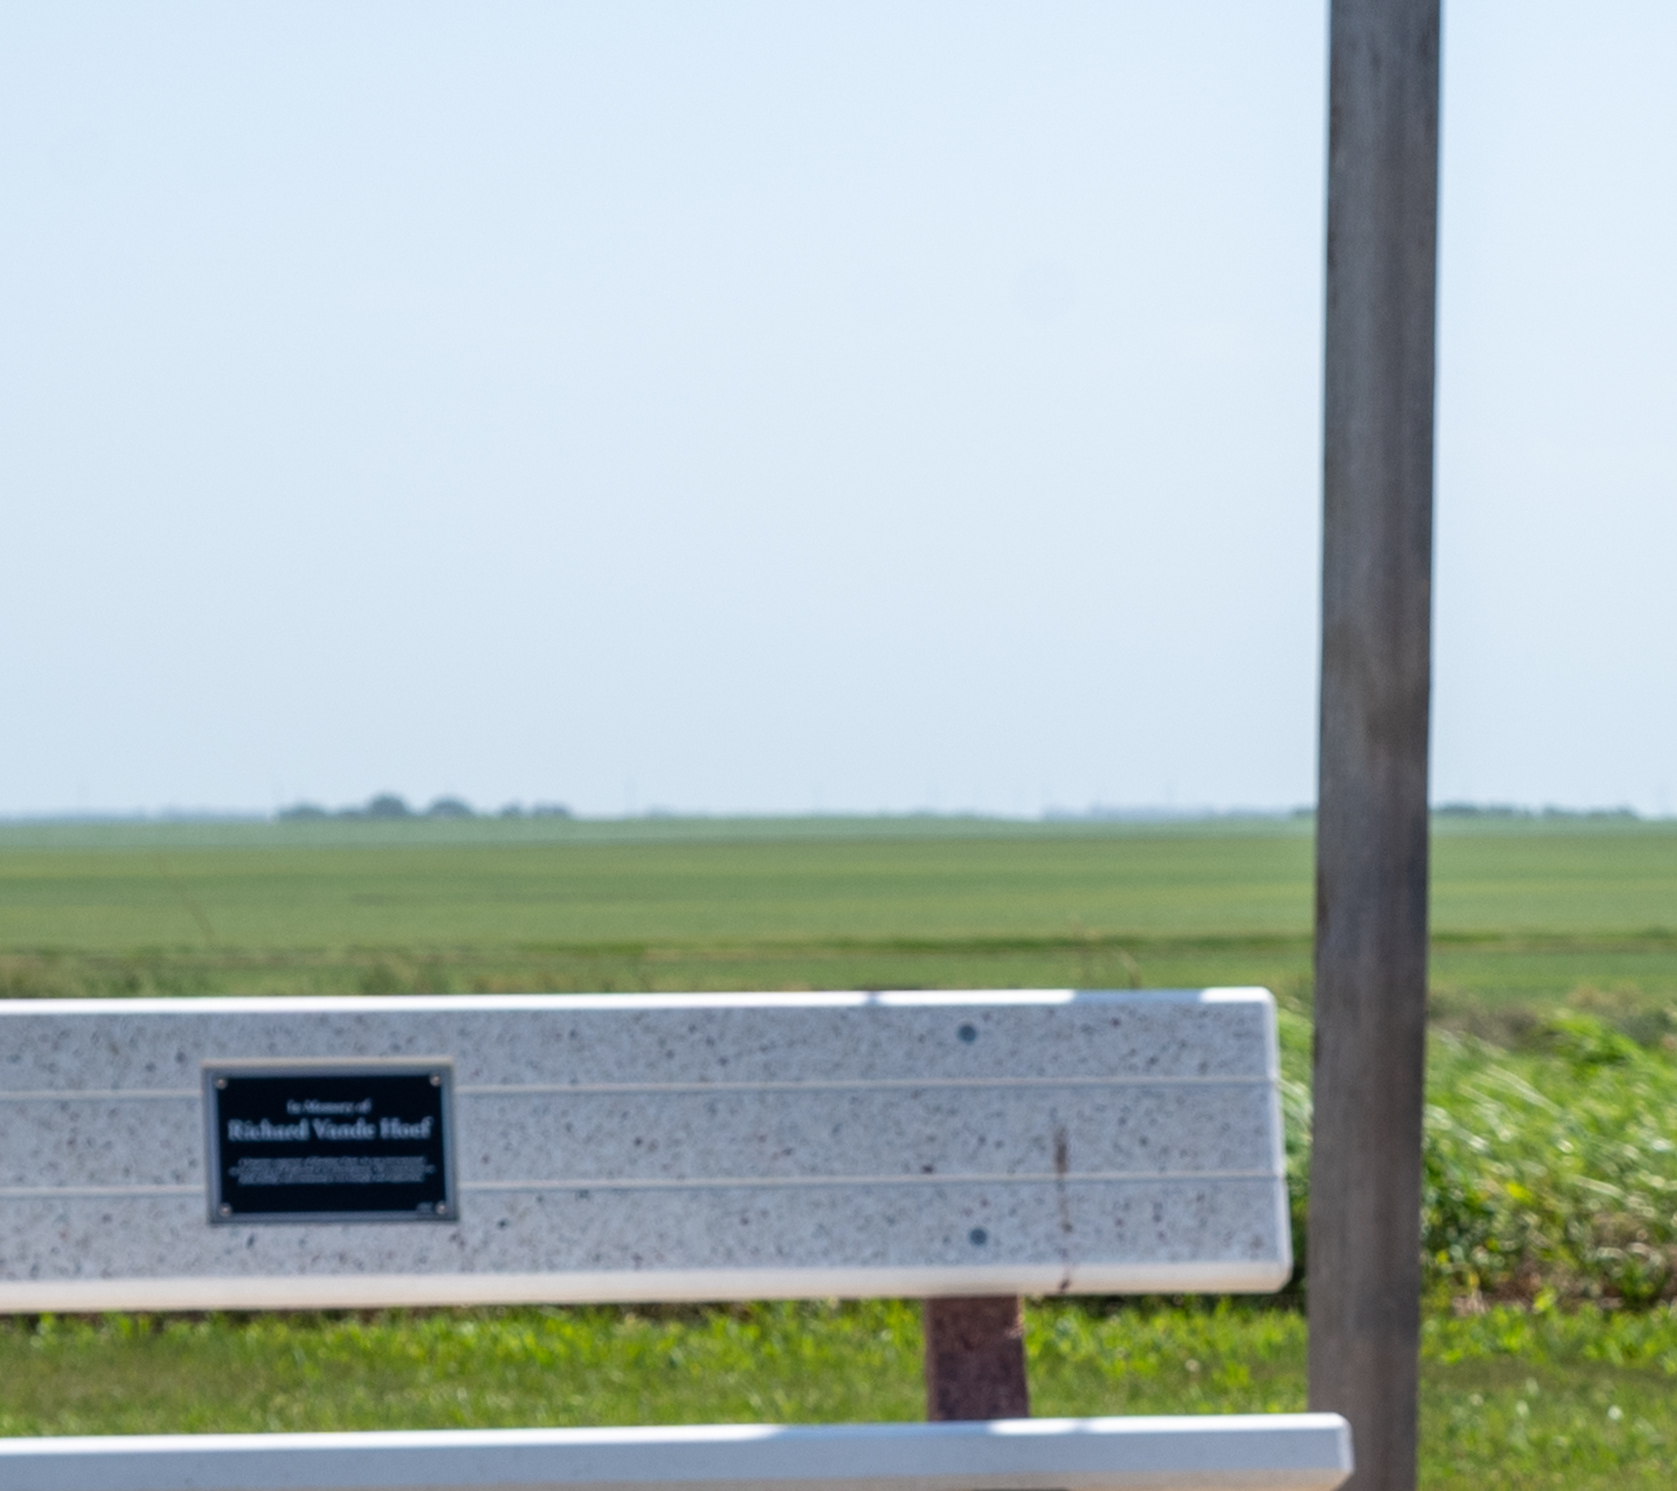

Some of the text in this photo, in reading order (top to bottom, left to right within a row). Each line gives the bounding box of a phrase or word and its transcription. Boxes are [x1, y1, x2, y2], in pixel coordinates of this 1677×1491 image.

[355, 1098, 372, 1115] of
[227, 1117, 310, 1141] Richard
[311, 1116, 375, 1140] Vande
